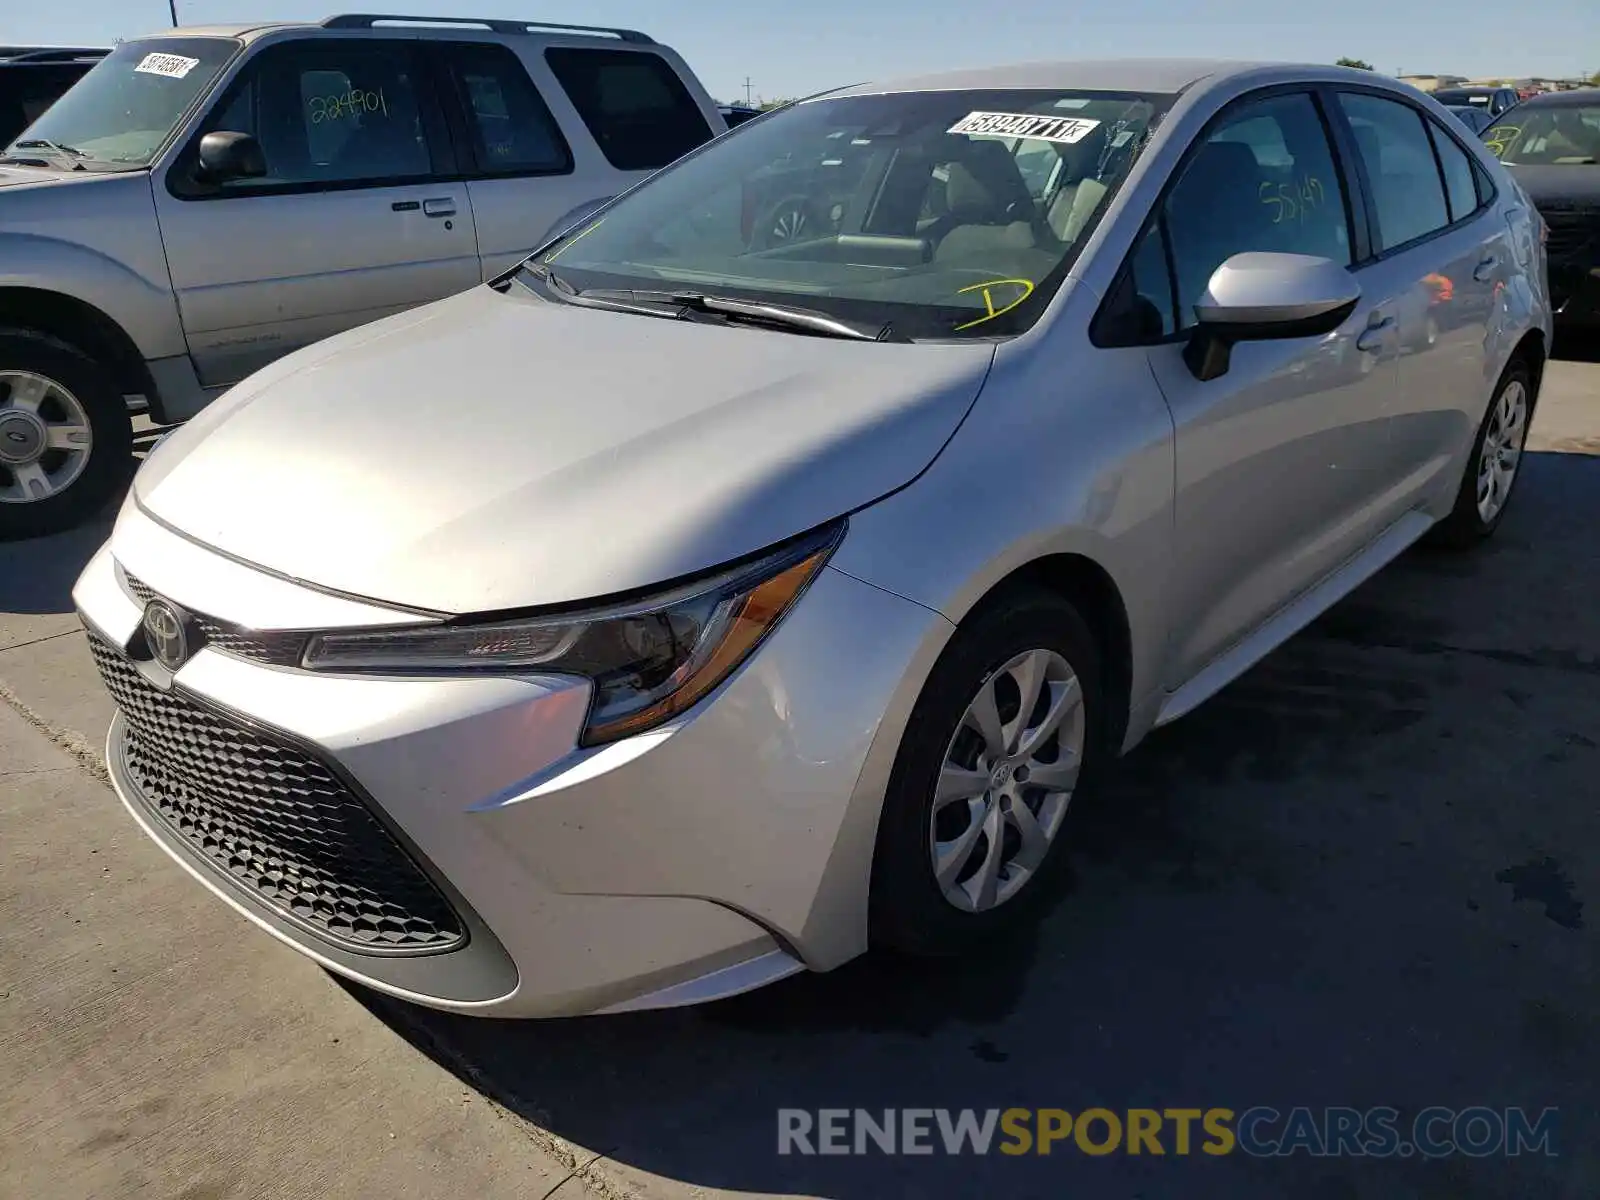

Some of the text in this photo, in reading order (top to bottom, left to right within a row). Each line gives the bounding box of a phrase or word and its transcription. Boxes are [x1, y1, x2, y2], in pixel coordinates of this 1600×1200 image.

[308, 86, 387, 123] 224901
[966, 113, 1076, 138] 58948711
[955, 279, 1034, 331] D
